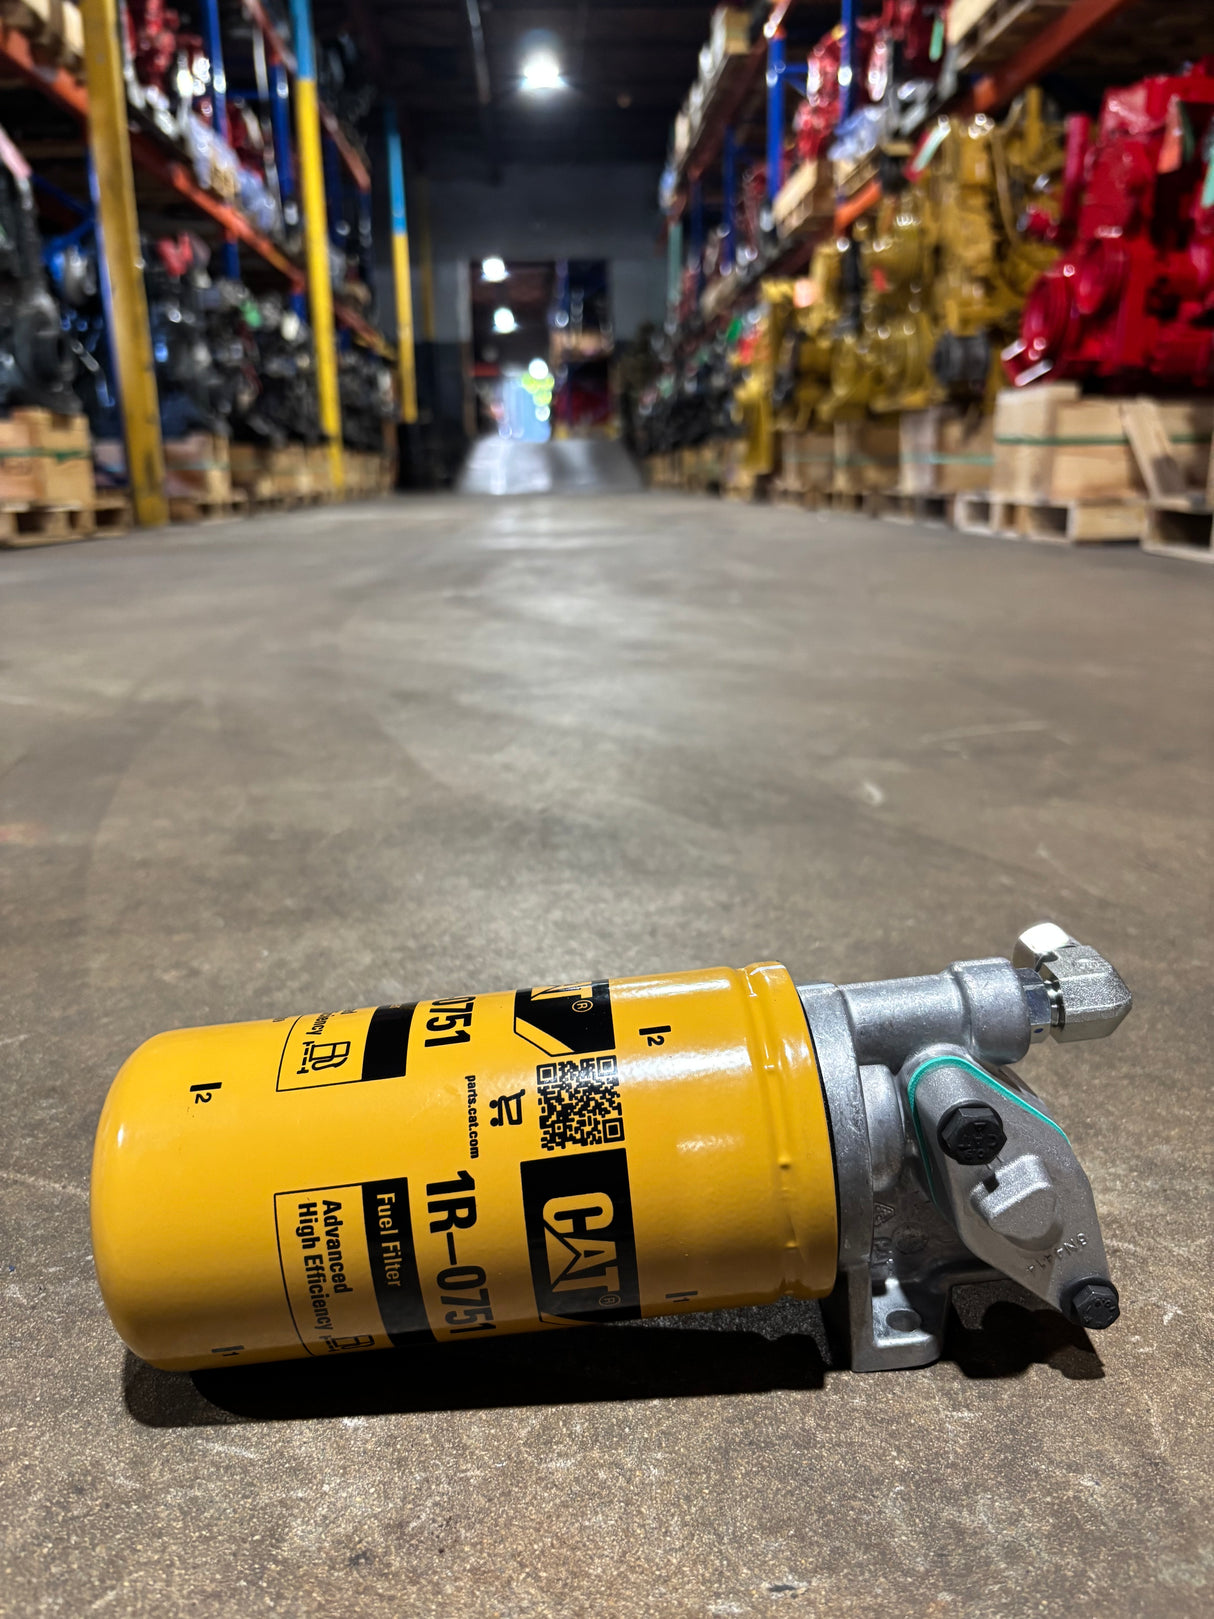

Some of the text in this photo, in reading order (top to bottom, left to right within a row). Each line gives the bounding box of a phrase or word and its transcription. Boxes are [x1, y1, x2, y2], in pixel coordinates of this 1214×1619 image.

[465, 1075, 480, 1160] parts.cat.com
[295, 1202, 334, 1331] High Efficiency
[322, 1199, 354, 1294] Advanced
[376, 1192, 404, 1287] Fuel Filter
